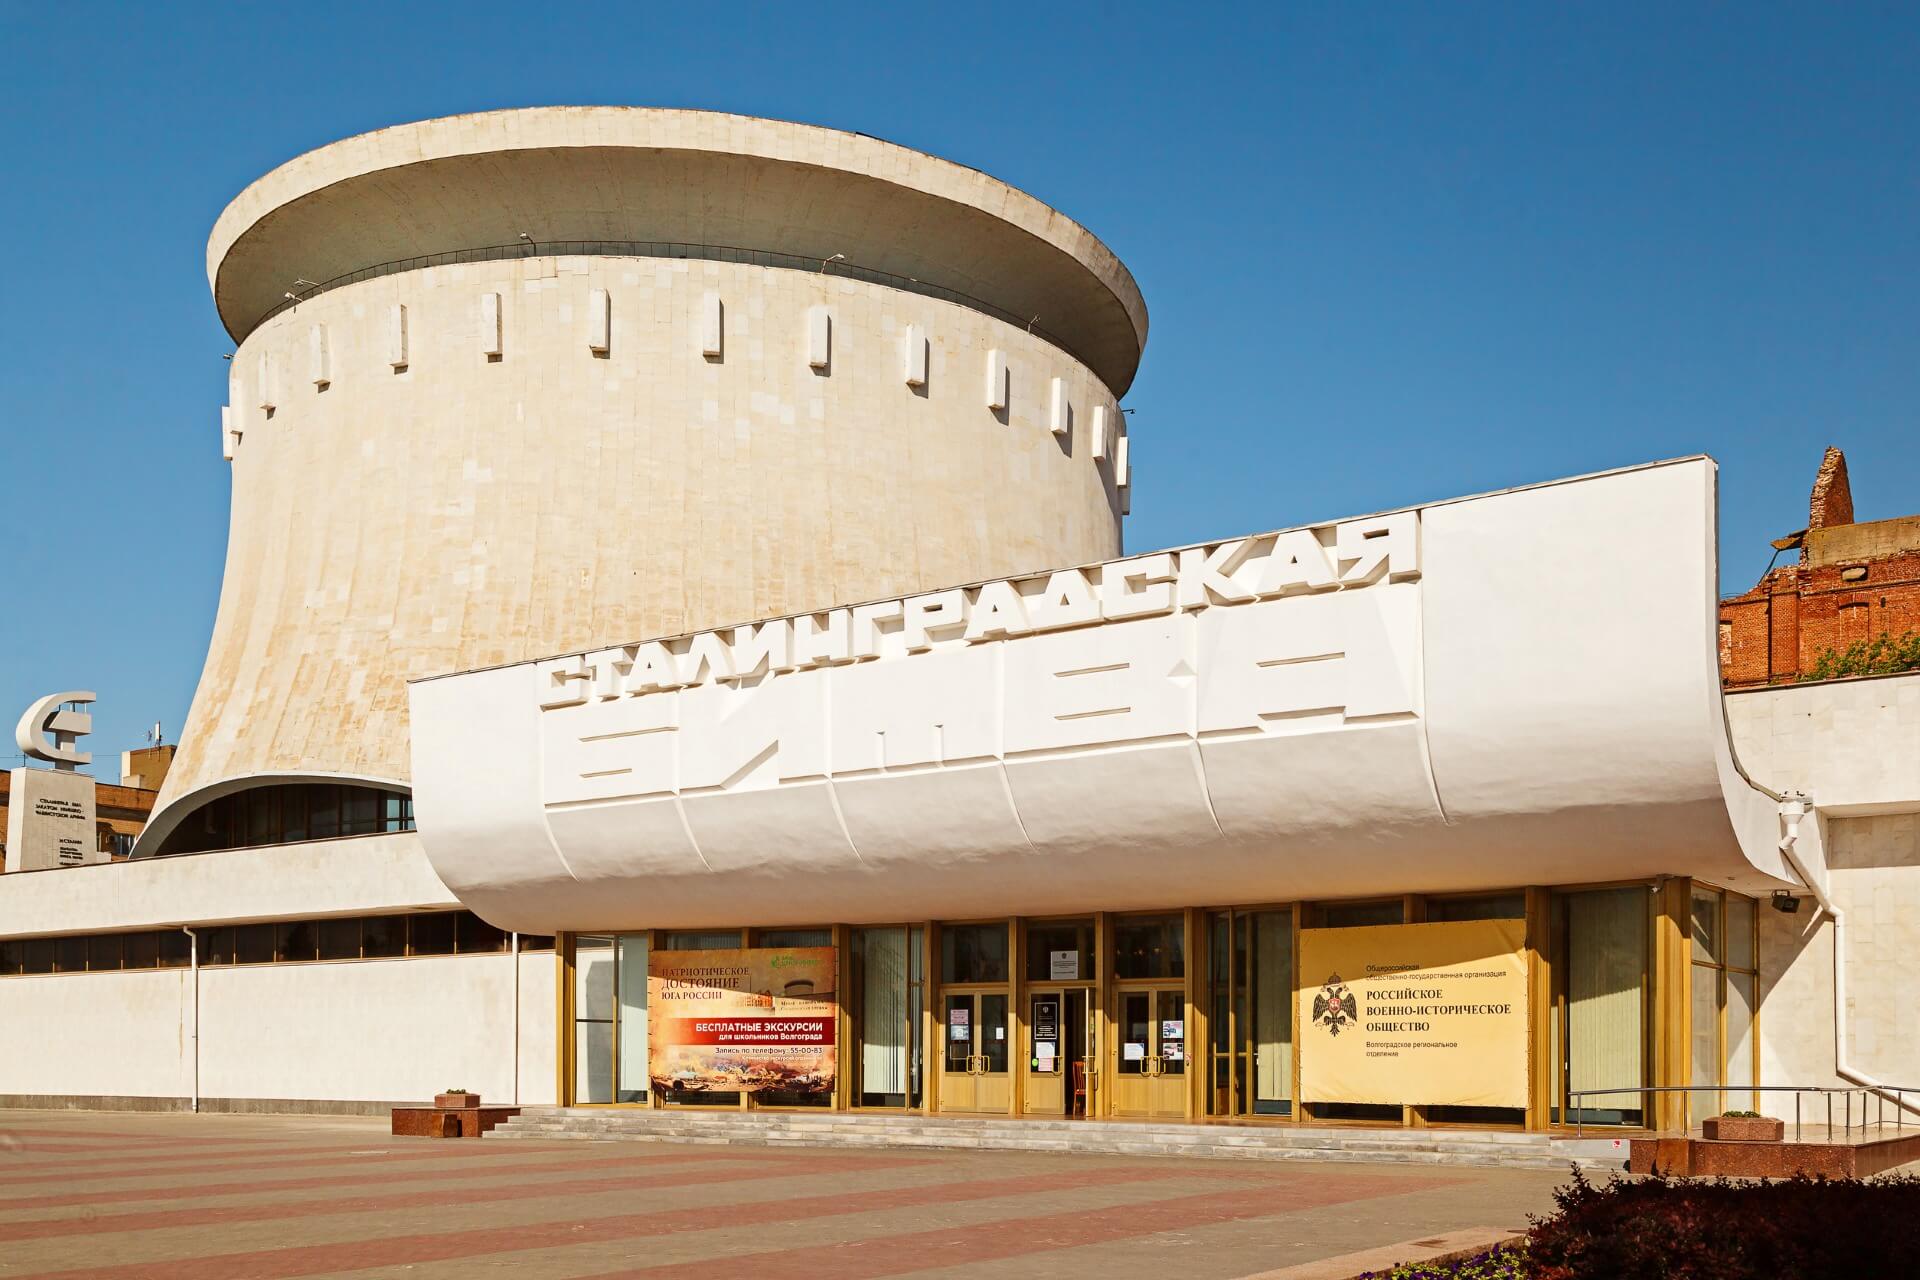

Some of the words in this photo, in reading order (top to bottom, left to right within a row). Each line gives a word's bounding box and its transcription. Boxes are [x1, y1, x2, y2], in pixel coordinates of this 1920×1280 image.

[537, 510, 1421, 712] СТАЛИНГРАДСКАЯ
[541, 586, 1420, 812] БИТВА
[662, 967, 749, 977] ПАТРИОТИЧЕСКОЕ
[1464, 971, 1507, 979] организация
[661, 977, 739, 990] ДОСТОЯНИЕ
[661, 991, 681, 1000] ЮГА
[683, 991, 722, 1000] РОССИИ
[1366, 988, 1443, 1000] РОССИЙСКОЕ
[1366, 1004, 1512, 1016] ВОЕННО-ИСТОРИЧЕСКОЕ
[695, 1023, 762, 1032] БЕСПЛАТНЫЕ
[764, 1022, 823, 1032] ЭКСКУРСИИ
[1366, 1022, 1430, 1032] ОБЩЕСТВО
[780, 1033, 823, 1041] Волгограда
[1366, 1041, 1411, 1049] Волгоградское
